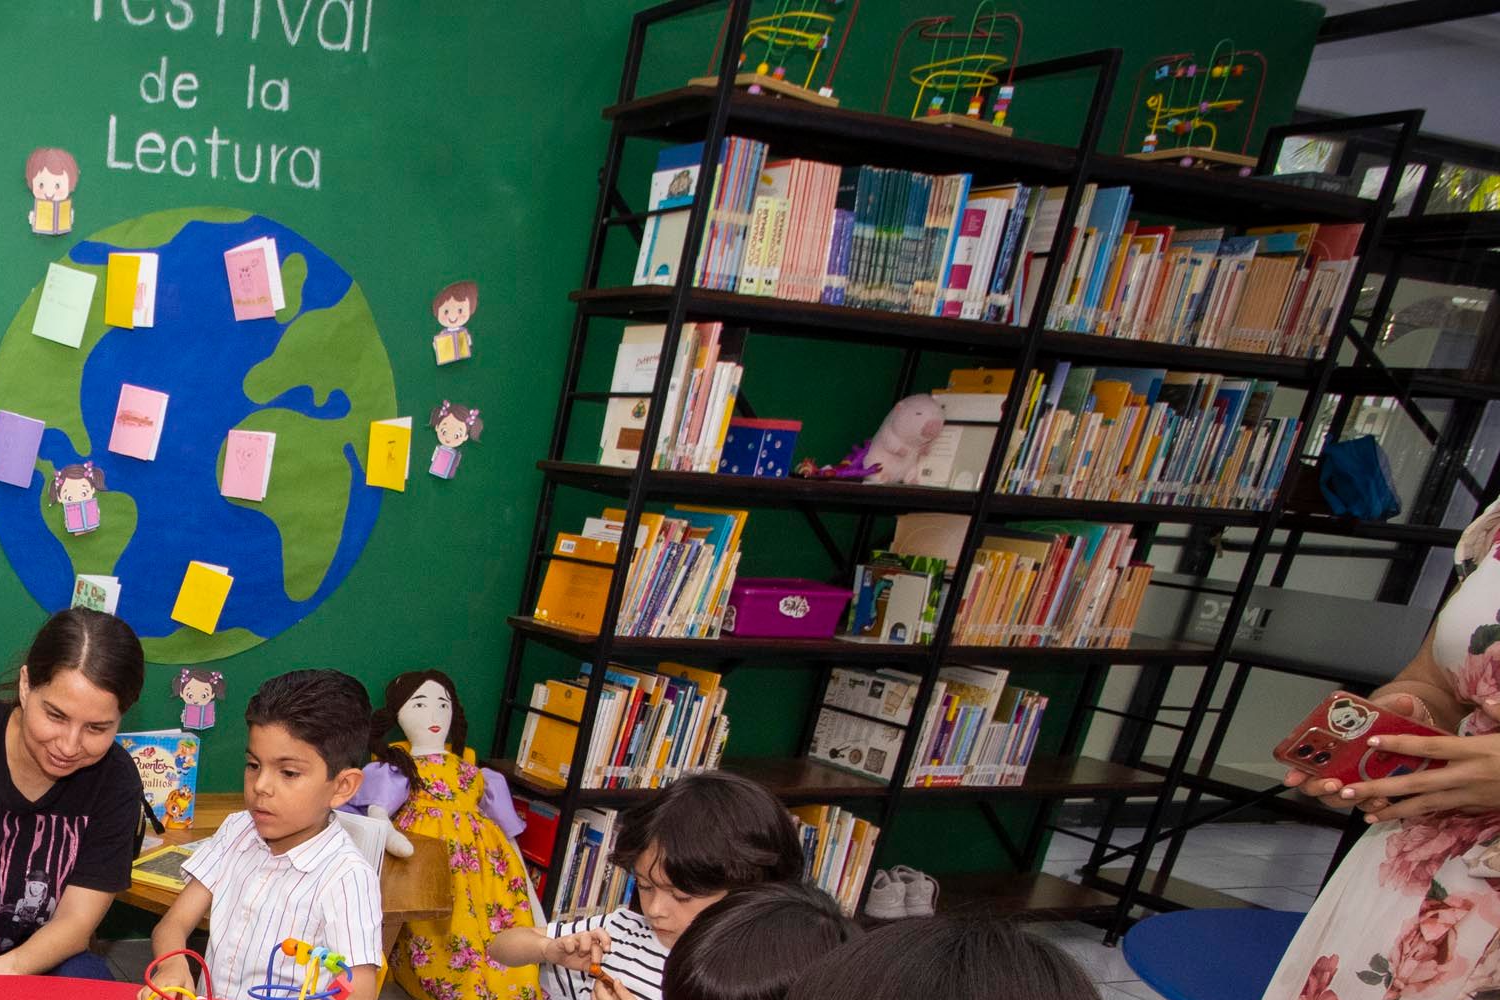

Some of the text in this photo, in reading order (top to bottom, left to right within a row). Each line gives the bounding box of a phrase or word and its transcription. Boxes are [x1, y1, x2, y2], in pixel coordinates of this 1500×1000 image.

[140, 56, 289, 112] de la
[106, 114, 320, 190] Lectura
[25, 814, 90, 903] PIN
